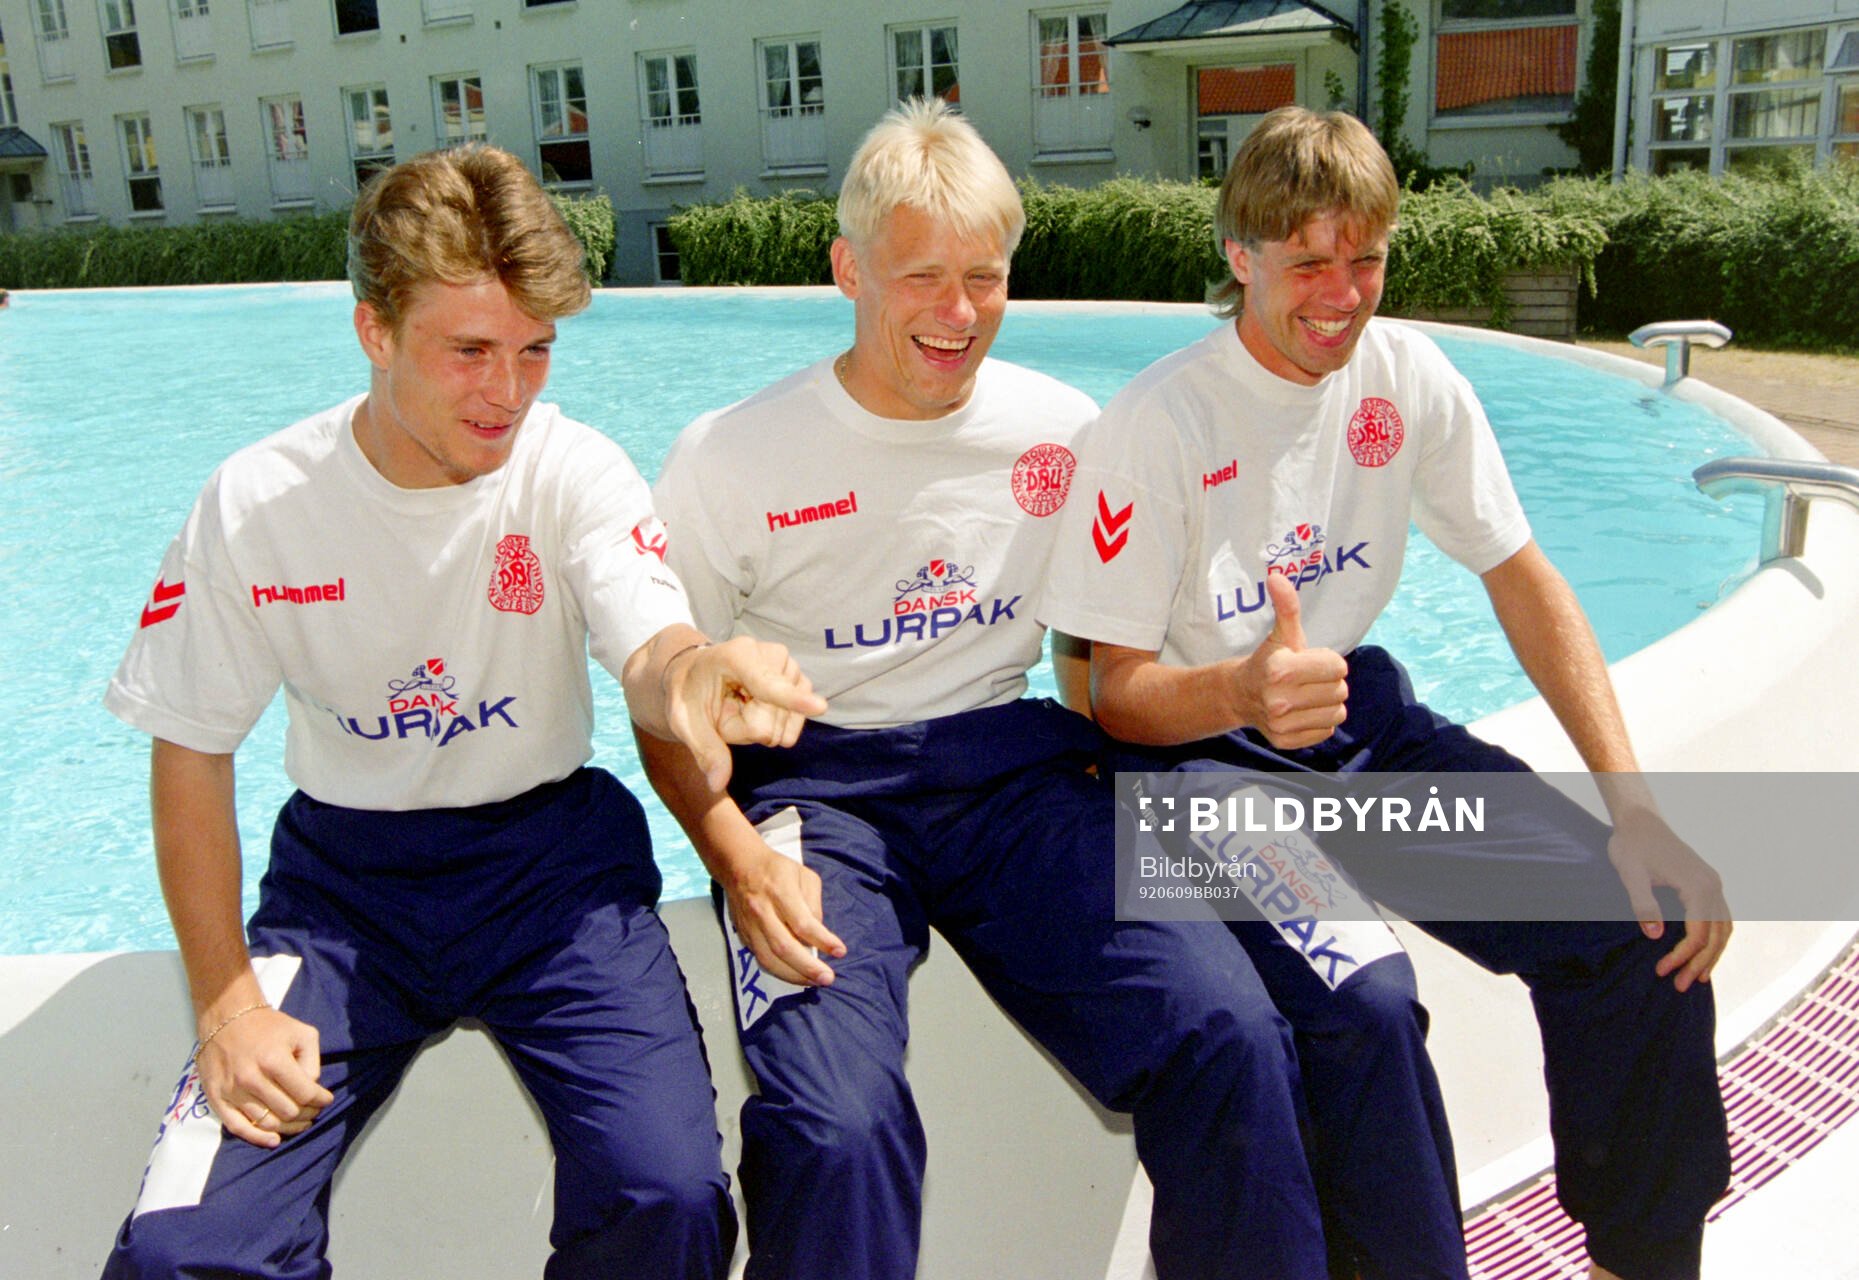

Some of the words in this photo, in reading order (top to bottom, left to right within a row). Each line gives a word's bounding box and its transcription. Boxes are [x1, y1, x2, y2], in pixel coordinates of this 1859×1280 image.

[1026, 468, 1062, 491] DBU
[766, 491, 857, 532] hummel
[252, 577, 344, 607] hummel
[894, 589, 977, 615] DANSK
[1217, 541, 1372, 622] LUPAK
[825, 595, 1023, 649] LURPAK
[1259, 844, 1329, 914] DANSK
